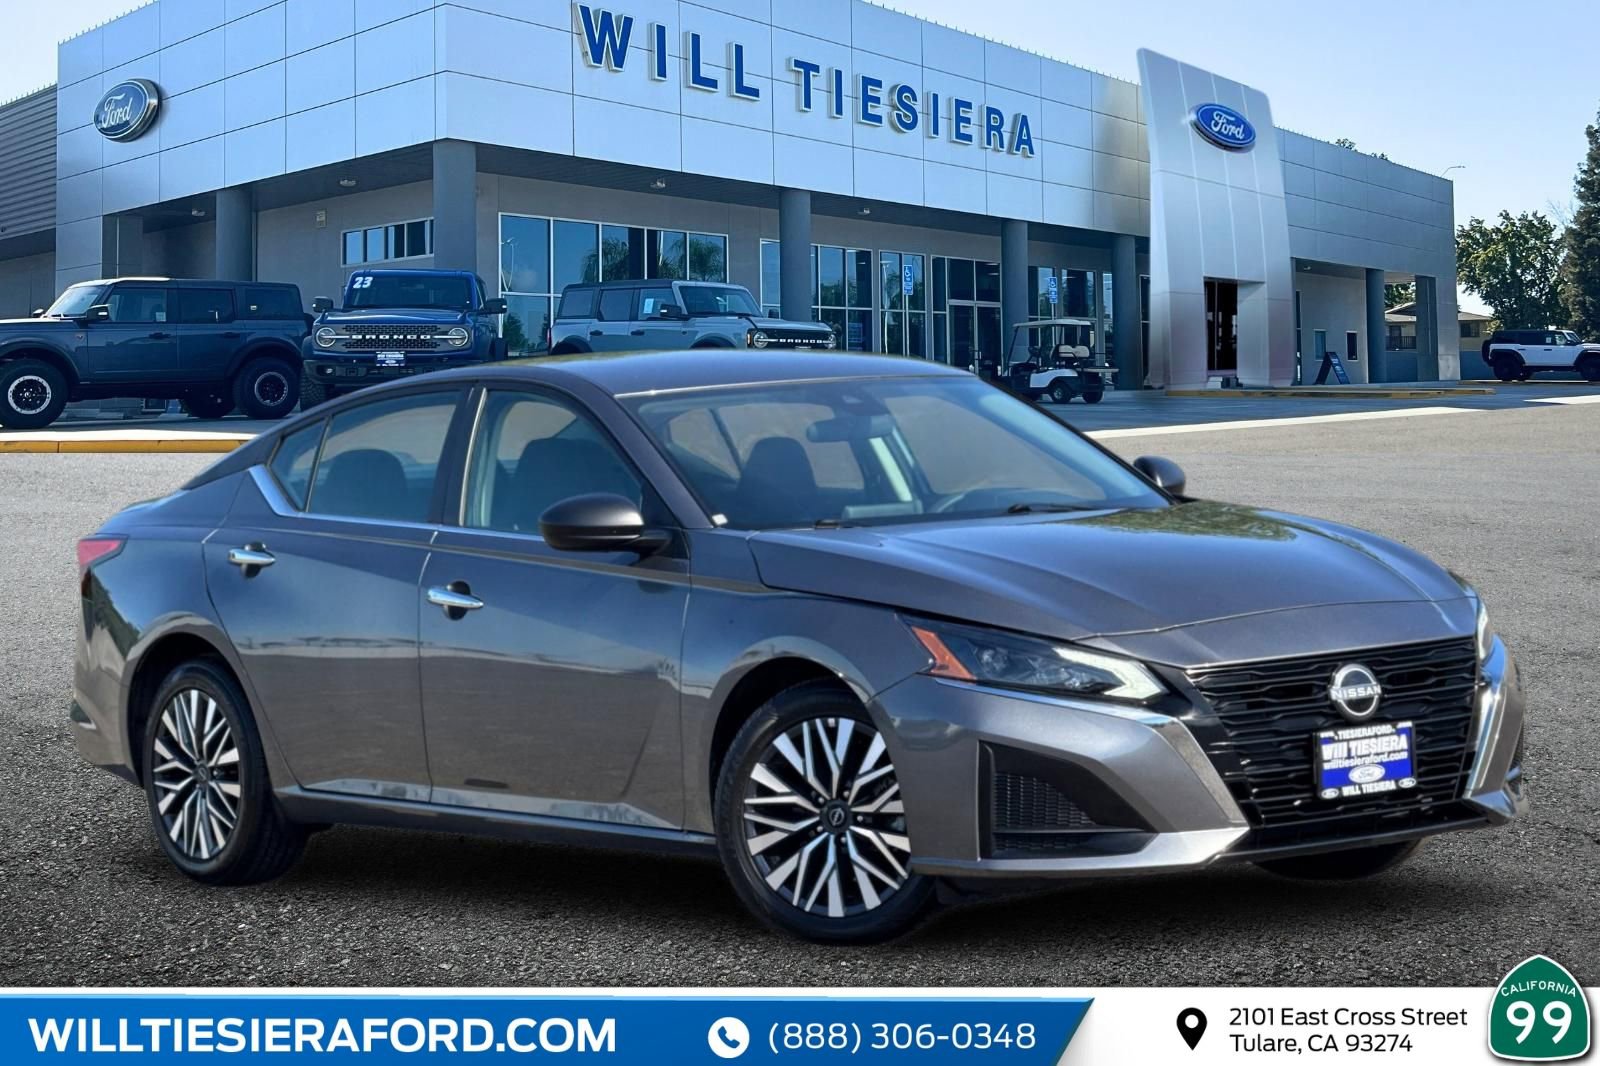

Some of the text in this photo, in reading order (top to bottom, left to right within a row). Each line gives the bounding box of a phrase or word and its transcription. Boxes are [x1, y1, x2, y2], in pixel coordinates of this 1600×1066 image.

[577, 3, 1034, 157] WILL TIESIERA
[102, 93, 133, 128] Ford
[1211, 111, 1245, 139] Ford
[352, 276, 373, 289] 23
[1330, 685, 1381, 701] NISSAN
[1349, 734, 1408, 756] TIESIERA
[1341, 785, 1361, 796] WILL
